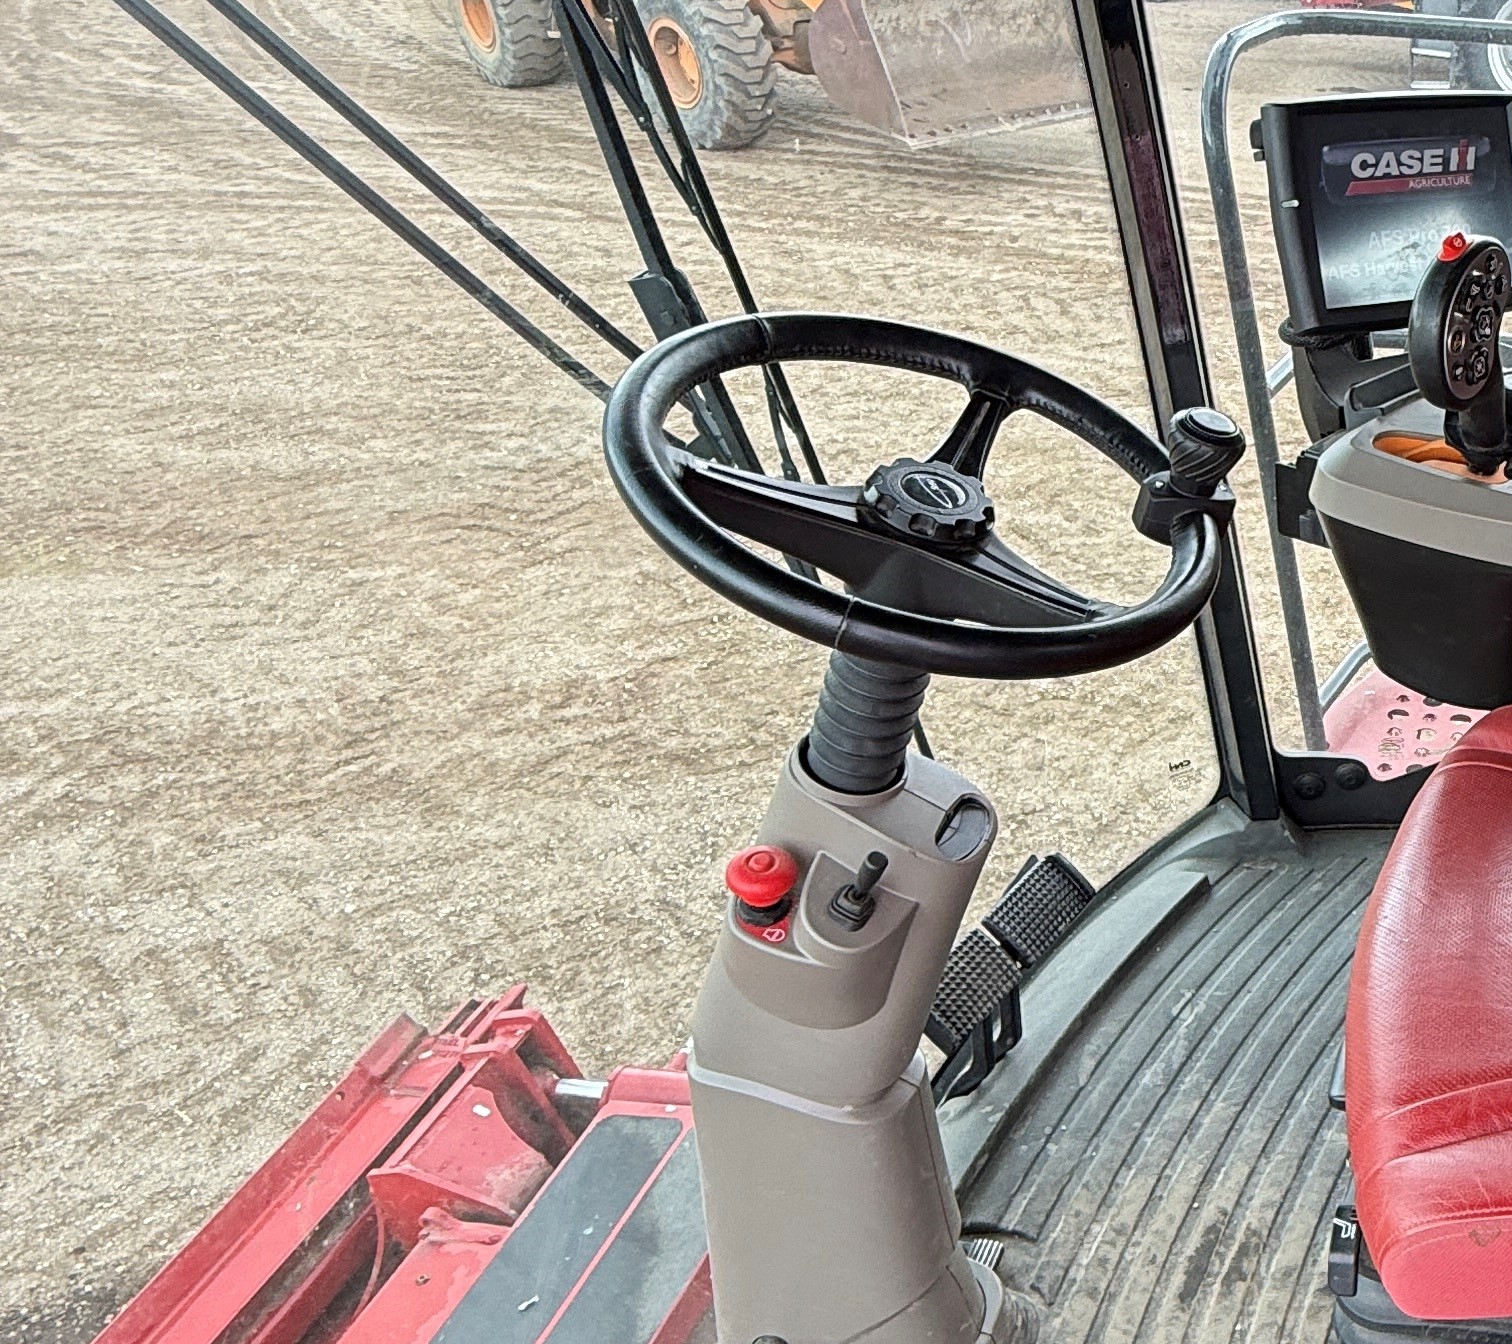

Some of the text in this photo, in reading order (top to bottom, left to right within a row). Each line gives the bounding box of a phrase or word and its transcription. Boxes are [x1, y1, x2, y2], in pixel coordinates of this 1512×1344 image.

[1350, 148, 1444, 179] CASE
[1408, 174, 1471, 189] AGRICULTURE
[1369, 229, 1403, 250] AFS
[1328, 263, 1361, 281] AFS
